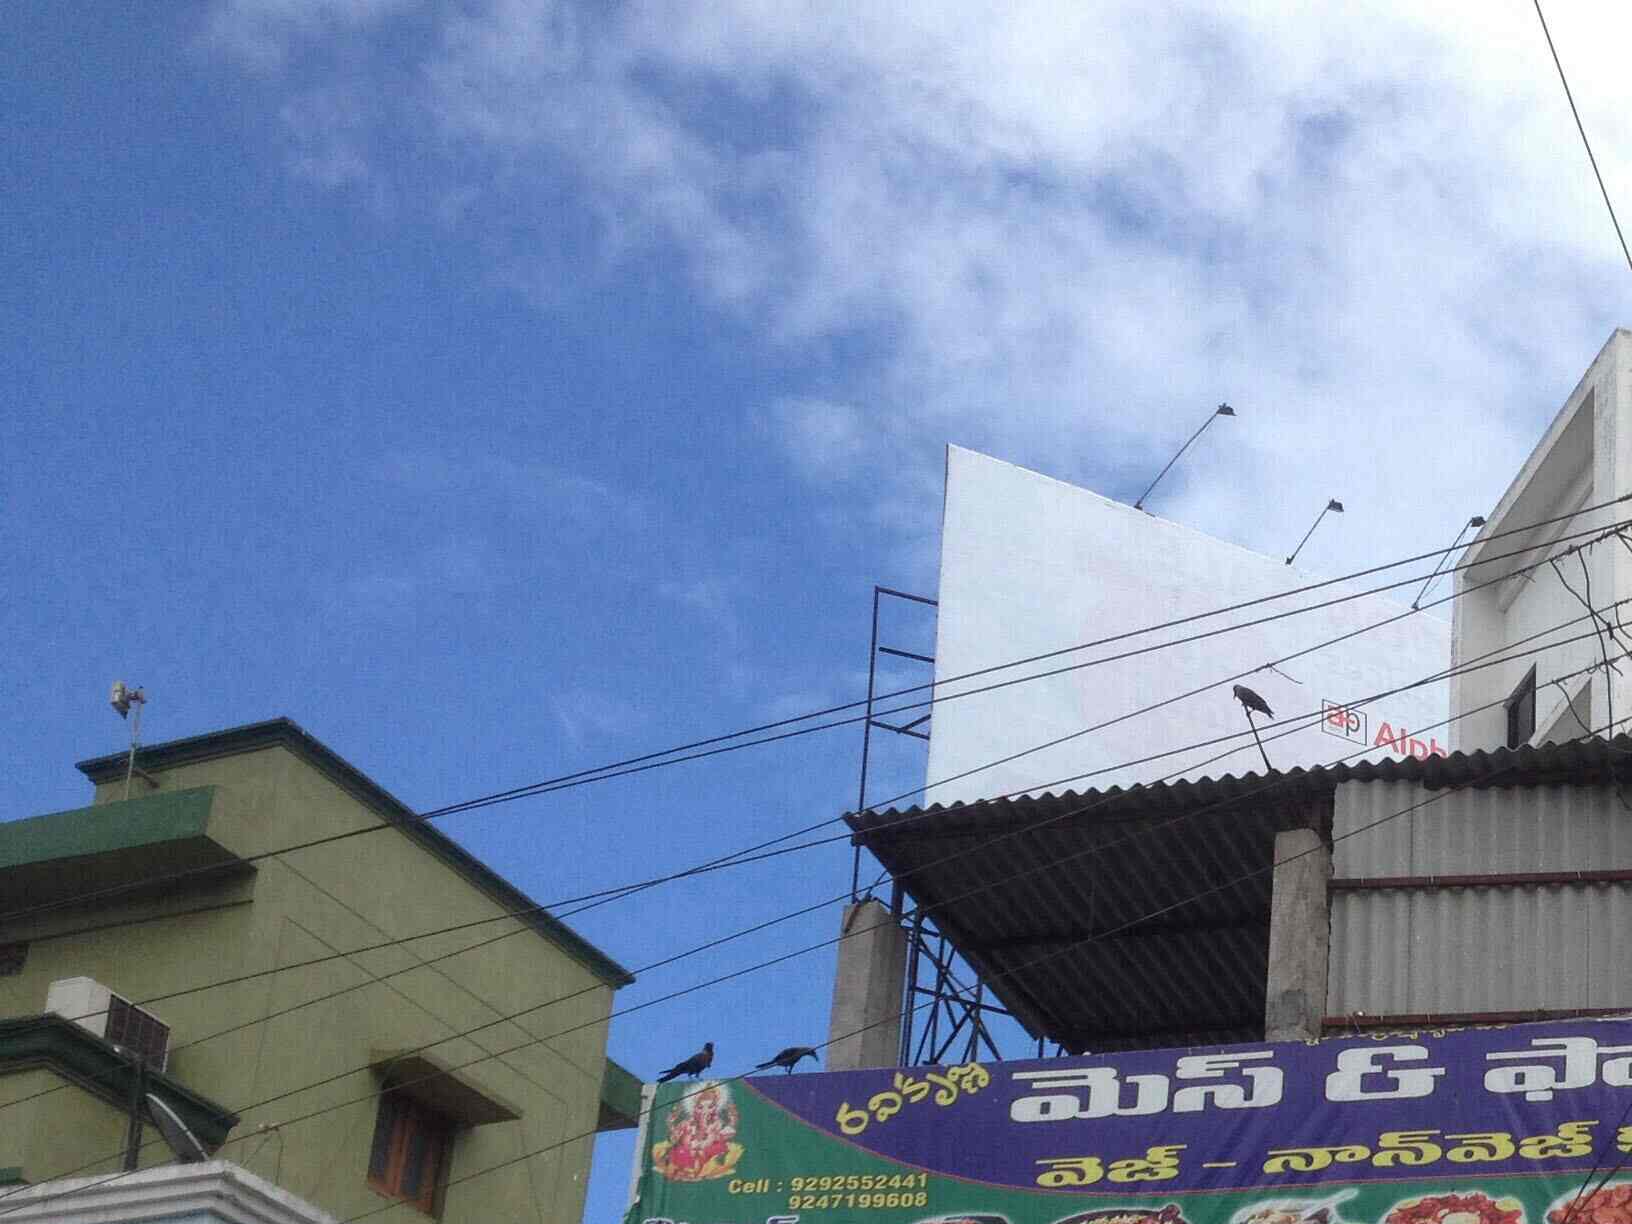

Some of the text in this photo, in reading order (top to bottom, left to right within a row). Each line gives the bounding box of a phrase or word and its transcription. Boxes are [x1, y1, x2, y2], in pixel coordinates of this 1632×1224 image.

[1010, 1050, 1284, 1123] మెస్
[1036, 1144, 1187, 1187] వెజ్
[728, 1178, 769, 1194] Cell
[791, 1173, 929, 1191] 9292552441
[788, 1192, 928, 1210] 9247199608
